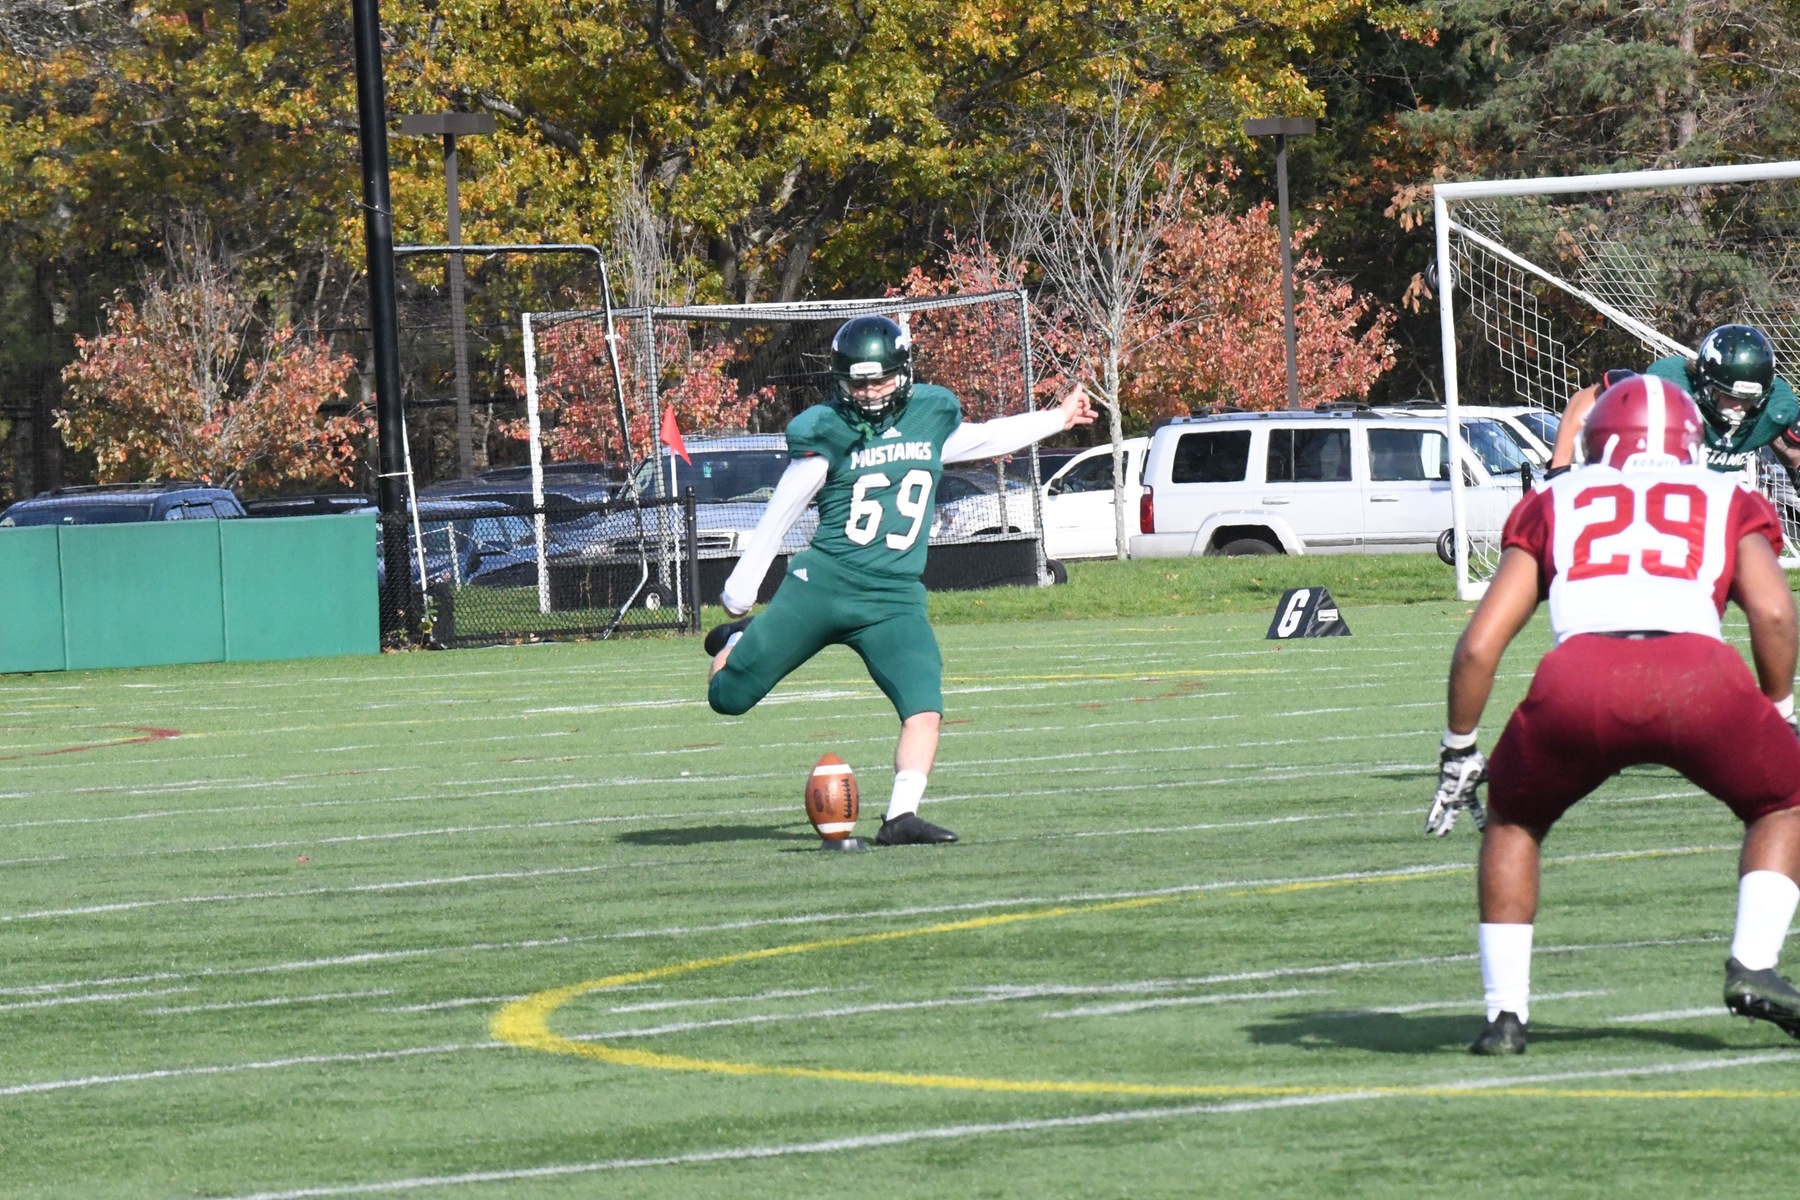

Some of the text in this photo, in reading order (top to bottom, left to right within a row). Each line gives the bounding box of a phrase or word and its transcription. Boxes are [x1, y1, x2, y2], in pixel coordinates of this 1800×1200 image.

[850, 441, 932, 470] MUSTANGS
[845, 469, 933, 551] 69
[1566, 482, 1708, 582] 29
[1277, 588, 1311, 638] G
